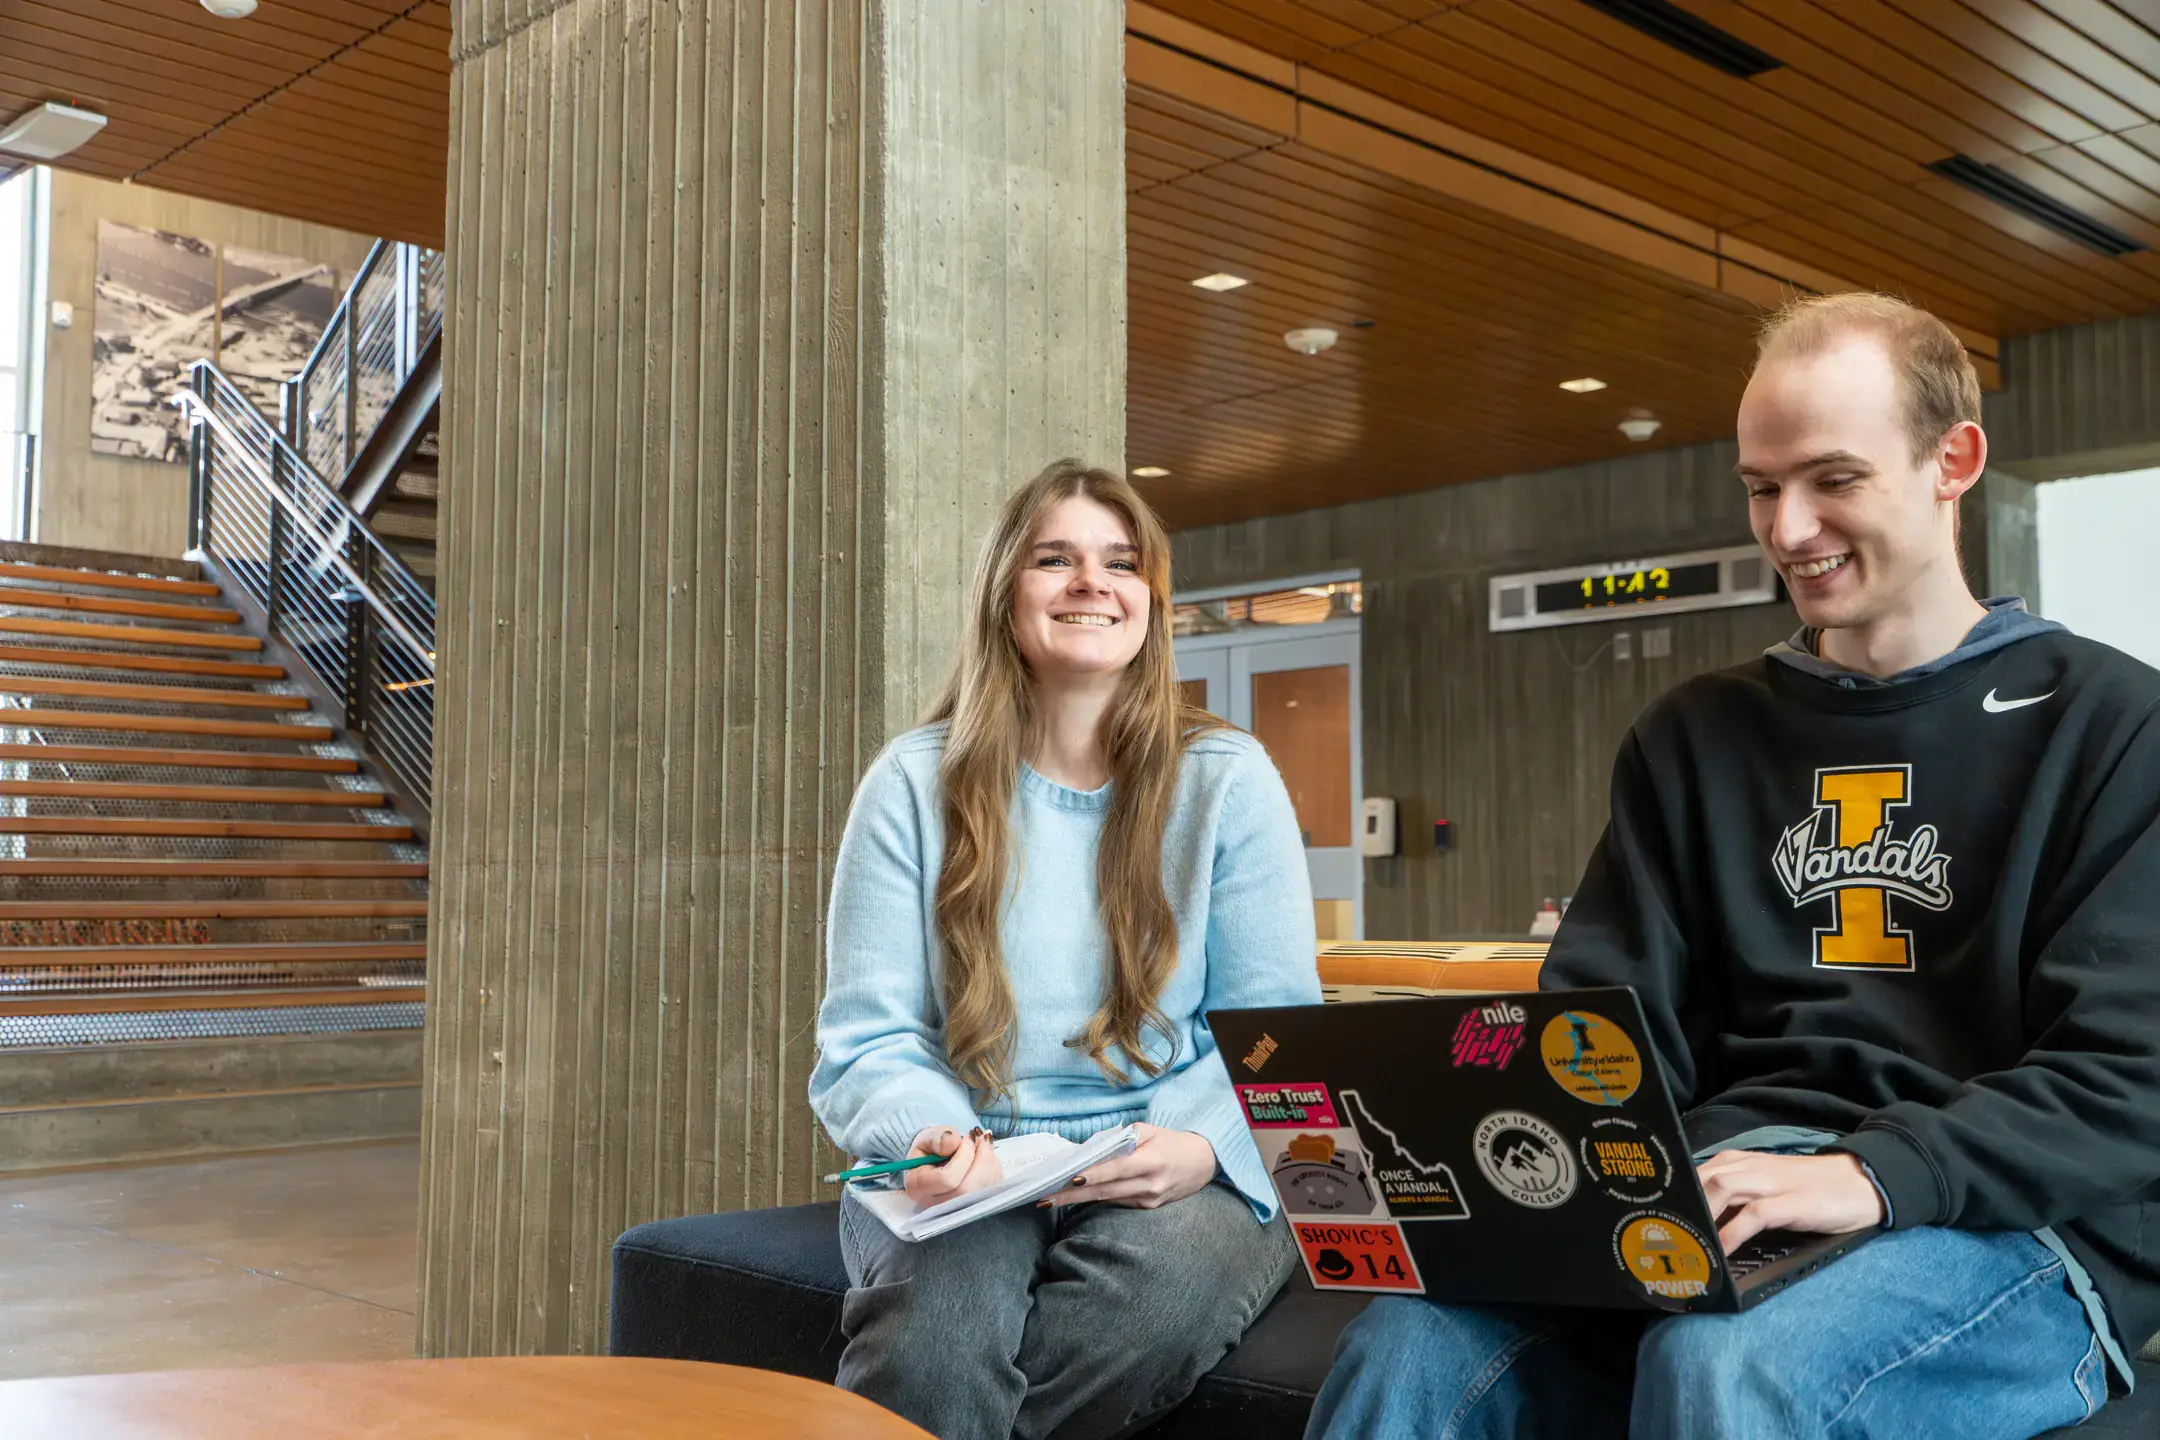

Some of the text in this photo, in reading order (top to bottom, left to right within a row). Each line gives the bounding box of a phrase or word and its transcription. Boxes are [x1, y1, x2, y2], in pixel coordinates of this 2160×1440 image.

[1774, 812, 1952, 906] Vandals
[1482, 1001, 1526, 1025] nile
[1243, 1032, 1279, 1073] ThinkPad
[1606, 1055, 1634, 1064] Idaho
[1243, 1088, 1324, 1104] Zero Trust
[1250, 1104, 1308, 1120] Built-in
[1478, 1116, 1558, 1149] NORTH IDAHO
[1594, 1142, 1651, 1160] VANDAL
[1379, 1170, 1414, 1181] ONCE
[1601, 1160, 1655, 1177] STRONG
[1386, 1182, 1448, 1193] A VANDAL,
[1511, 1187, 1567, 1204] COLLEGE
[1301, 1228, 1393, 1245] SHOVIC'S
[1658, 1213, 1699, 1237] UNIVERSITY
[1705, 1247, 1718, 1268] IDAHO
[1360, 1253, 1406, 1280] 14
[1644, 1280, 1708, 1295] POWER
